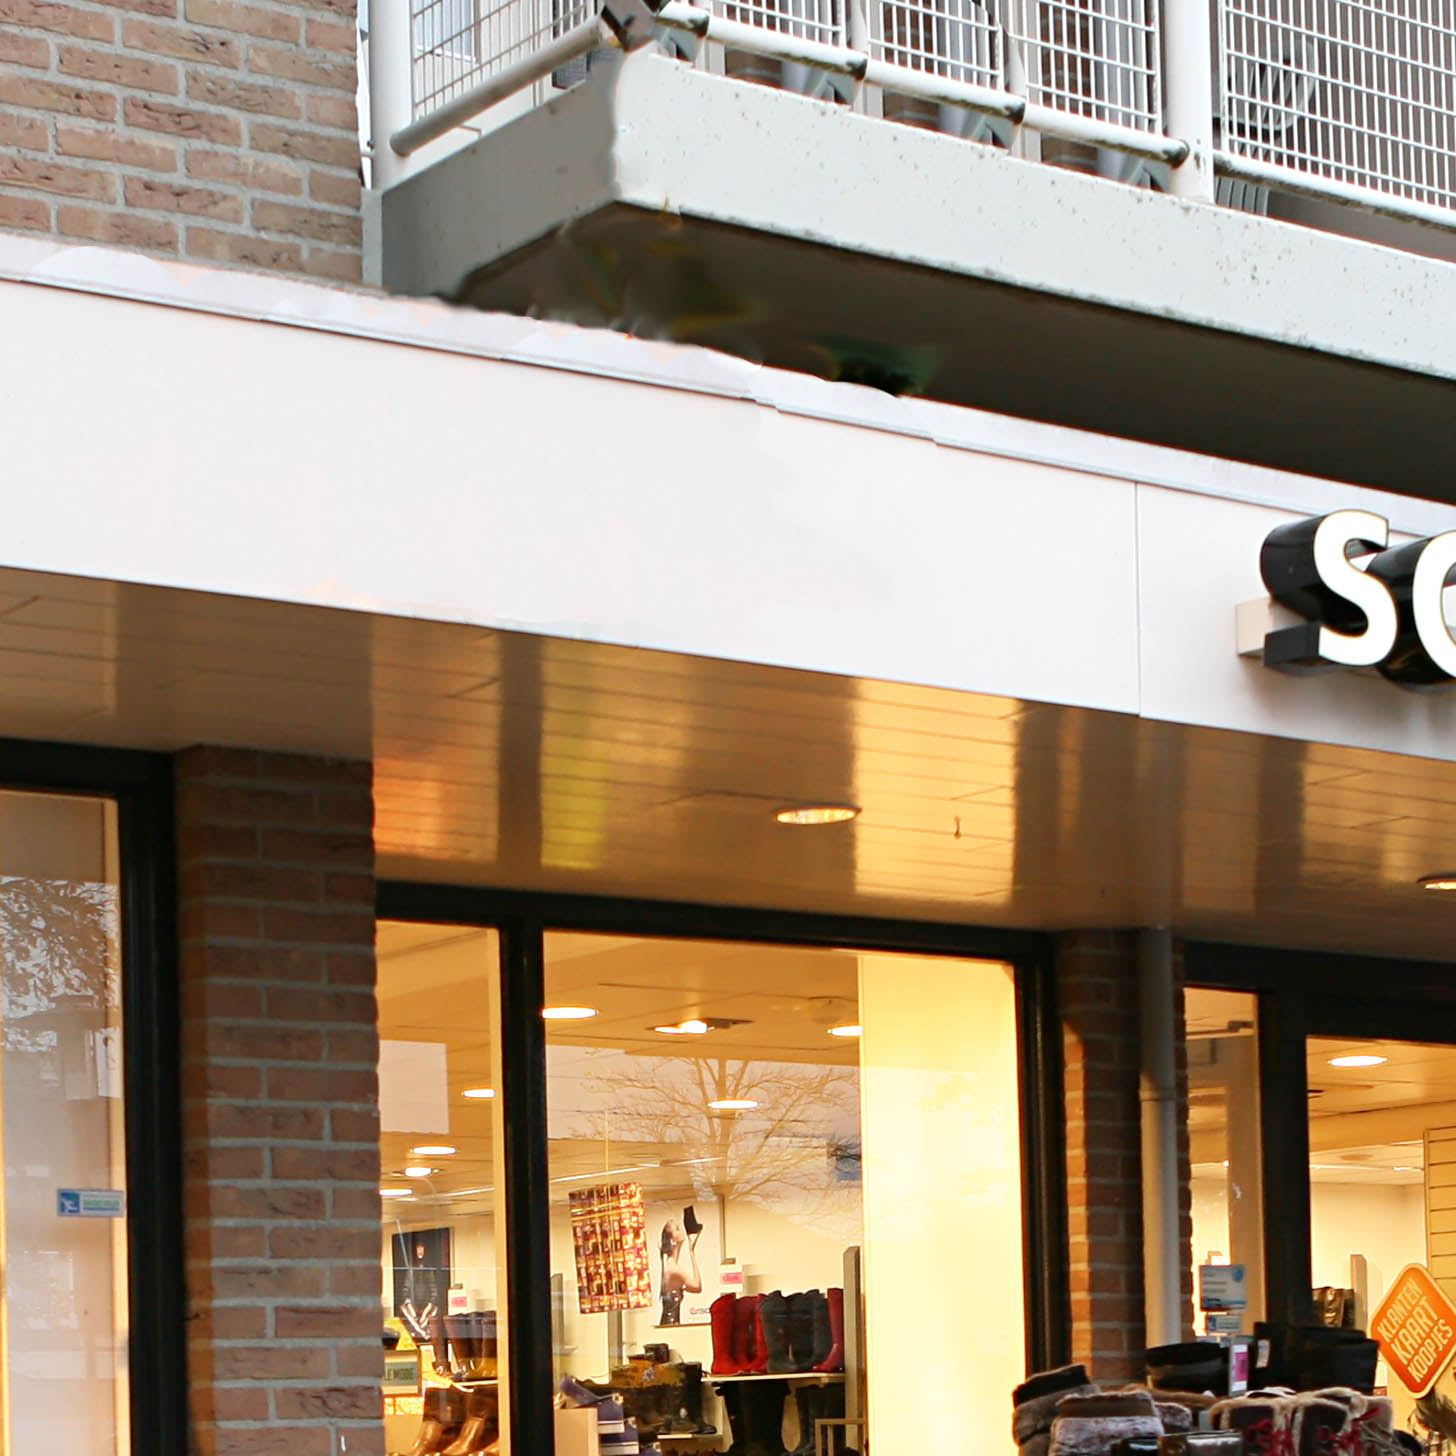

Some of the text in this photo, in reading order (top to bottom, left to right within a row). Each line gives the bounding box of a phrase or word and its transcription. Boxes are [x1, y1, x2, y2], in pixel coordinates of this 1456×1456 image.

[1377, 1278, 1424, 1342] KLANTEN
[1391, 1295, 1439, 1366] KAART
[1407, 1318, 1454, 1383] KOOPJES
